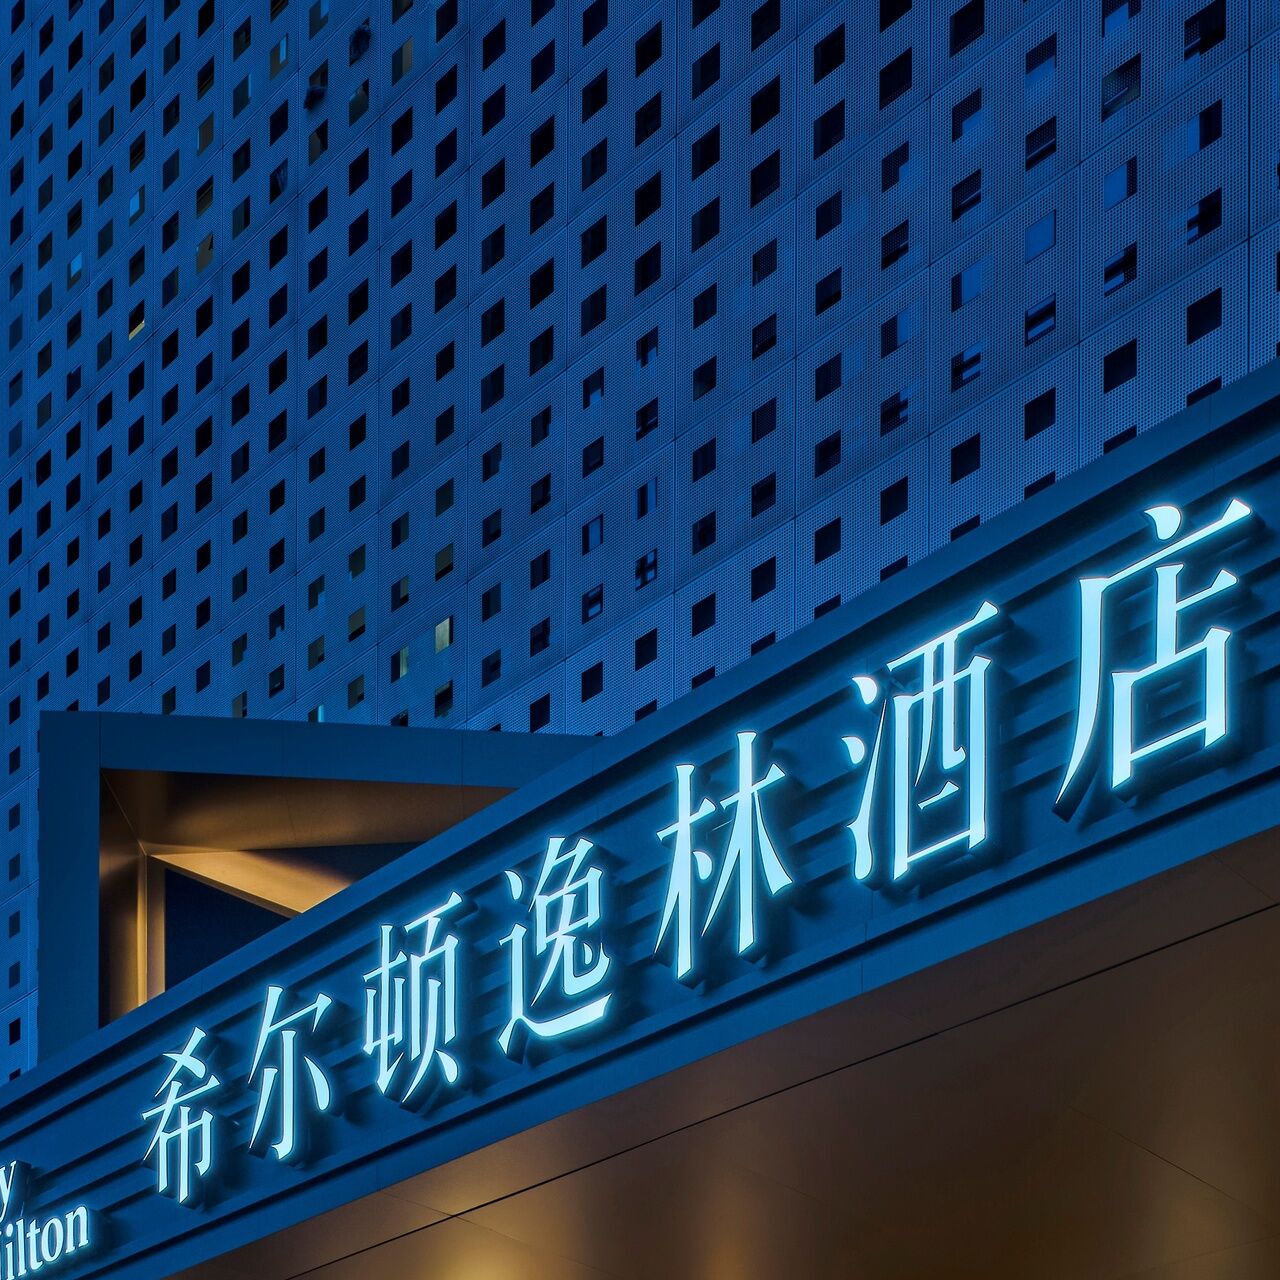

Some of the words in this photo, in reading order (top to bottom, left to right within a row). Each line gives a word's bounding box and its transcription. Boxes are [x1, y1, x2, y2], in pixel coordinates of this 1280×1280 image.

[136, 497, 1253, 1205] 希尔顿逸林酒店
